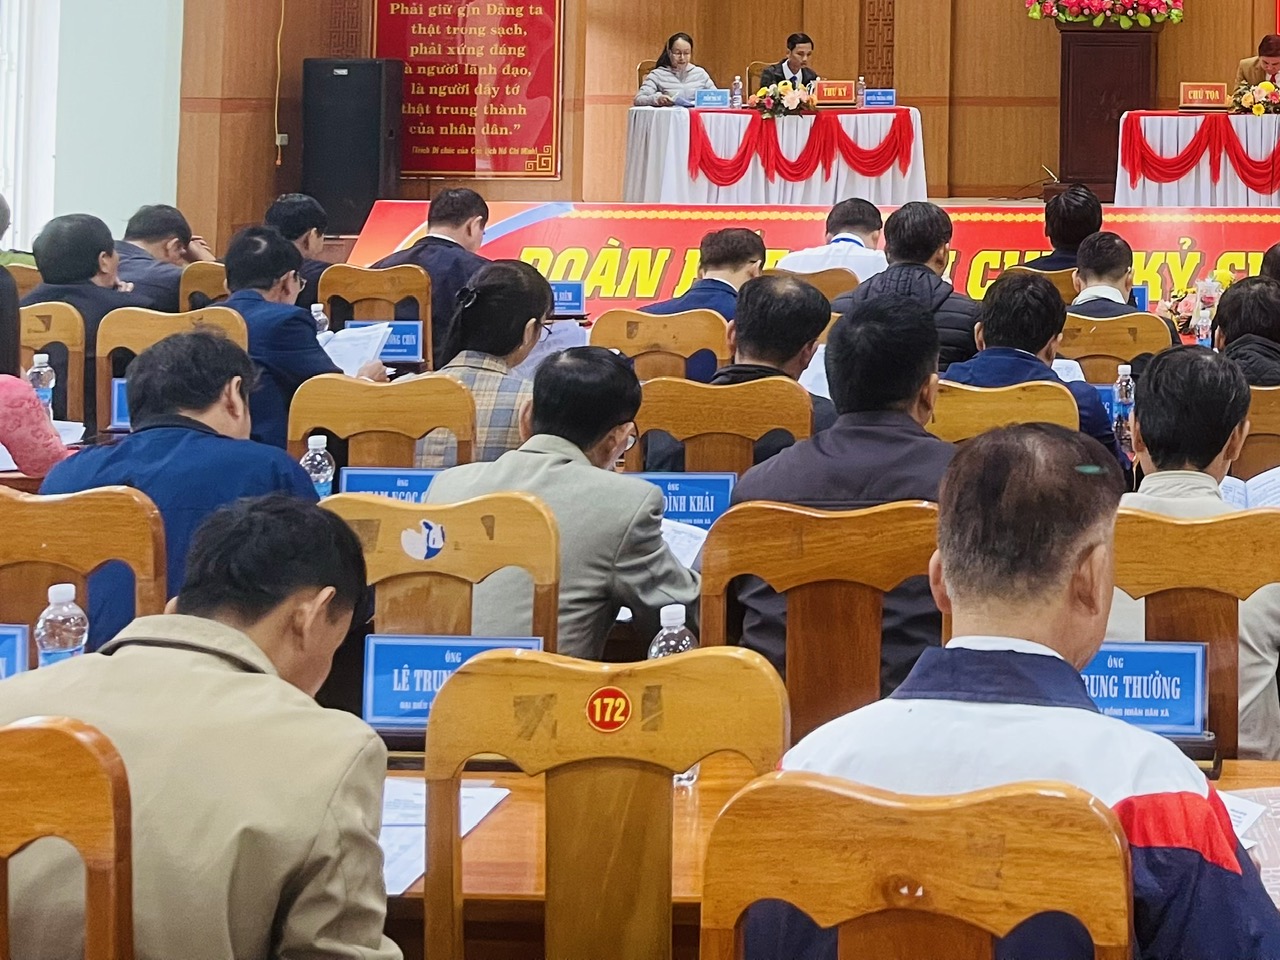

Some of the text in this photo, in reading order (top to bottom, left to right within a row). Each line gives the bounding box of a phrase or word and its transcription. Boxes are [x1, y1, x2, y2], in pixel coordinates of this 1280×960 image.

[411, 24, 527, 37] thật trong sạch,
[410, 43, 442, 57] phải
[447, 44, 484, 57] xứng
[436, 106, 477, 117] trung
[483, 104, 527, 115] thành
[409, 122, 434, 135] của
[440, 123, 476, 135] nhân
[445, 650, 461, 663] ÔNG
[1107, 655, 1124, 668] ÔNG
[393, 664, 410, 691] LÊ
[1080, 670, 1180, 699] RUNG THƯỞNG
[593, 697, 626, 722] 172
